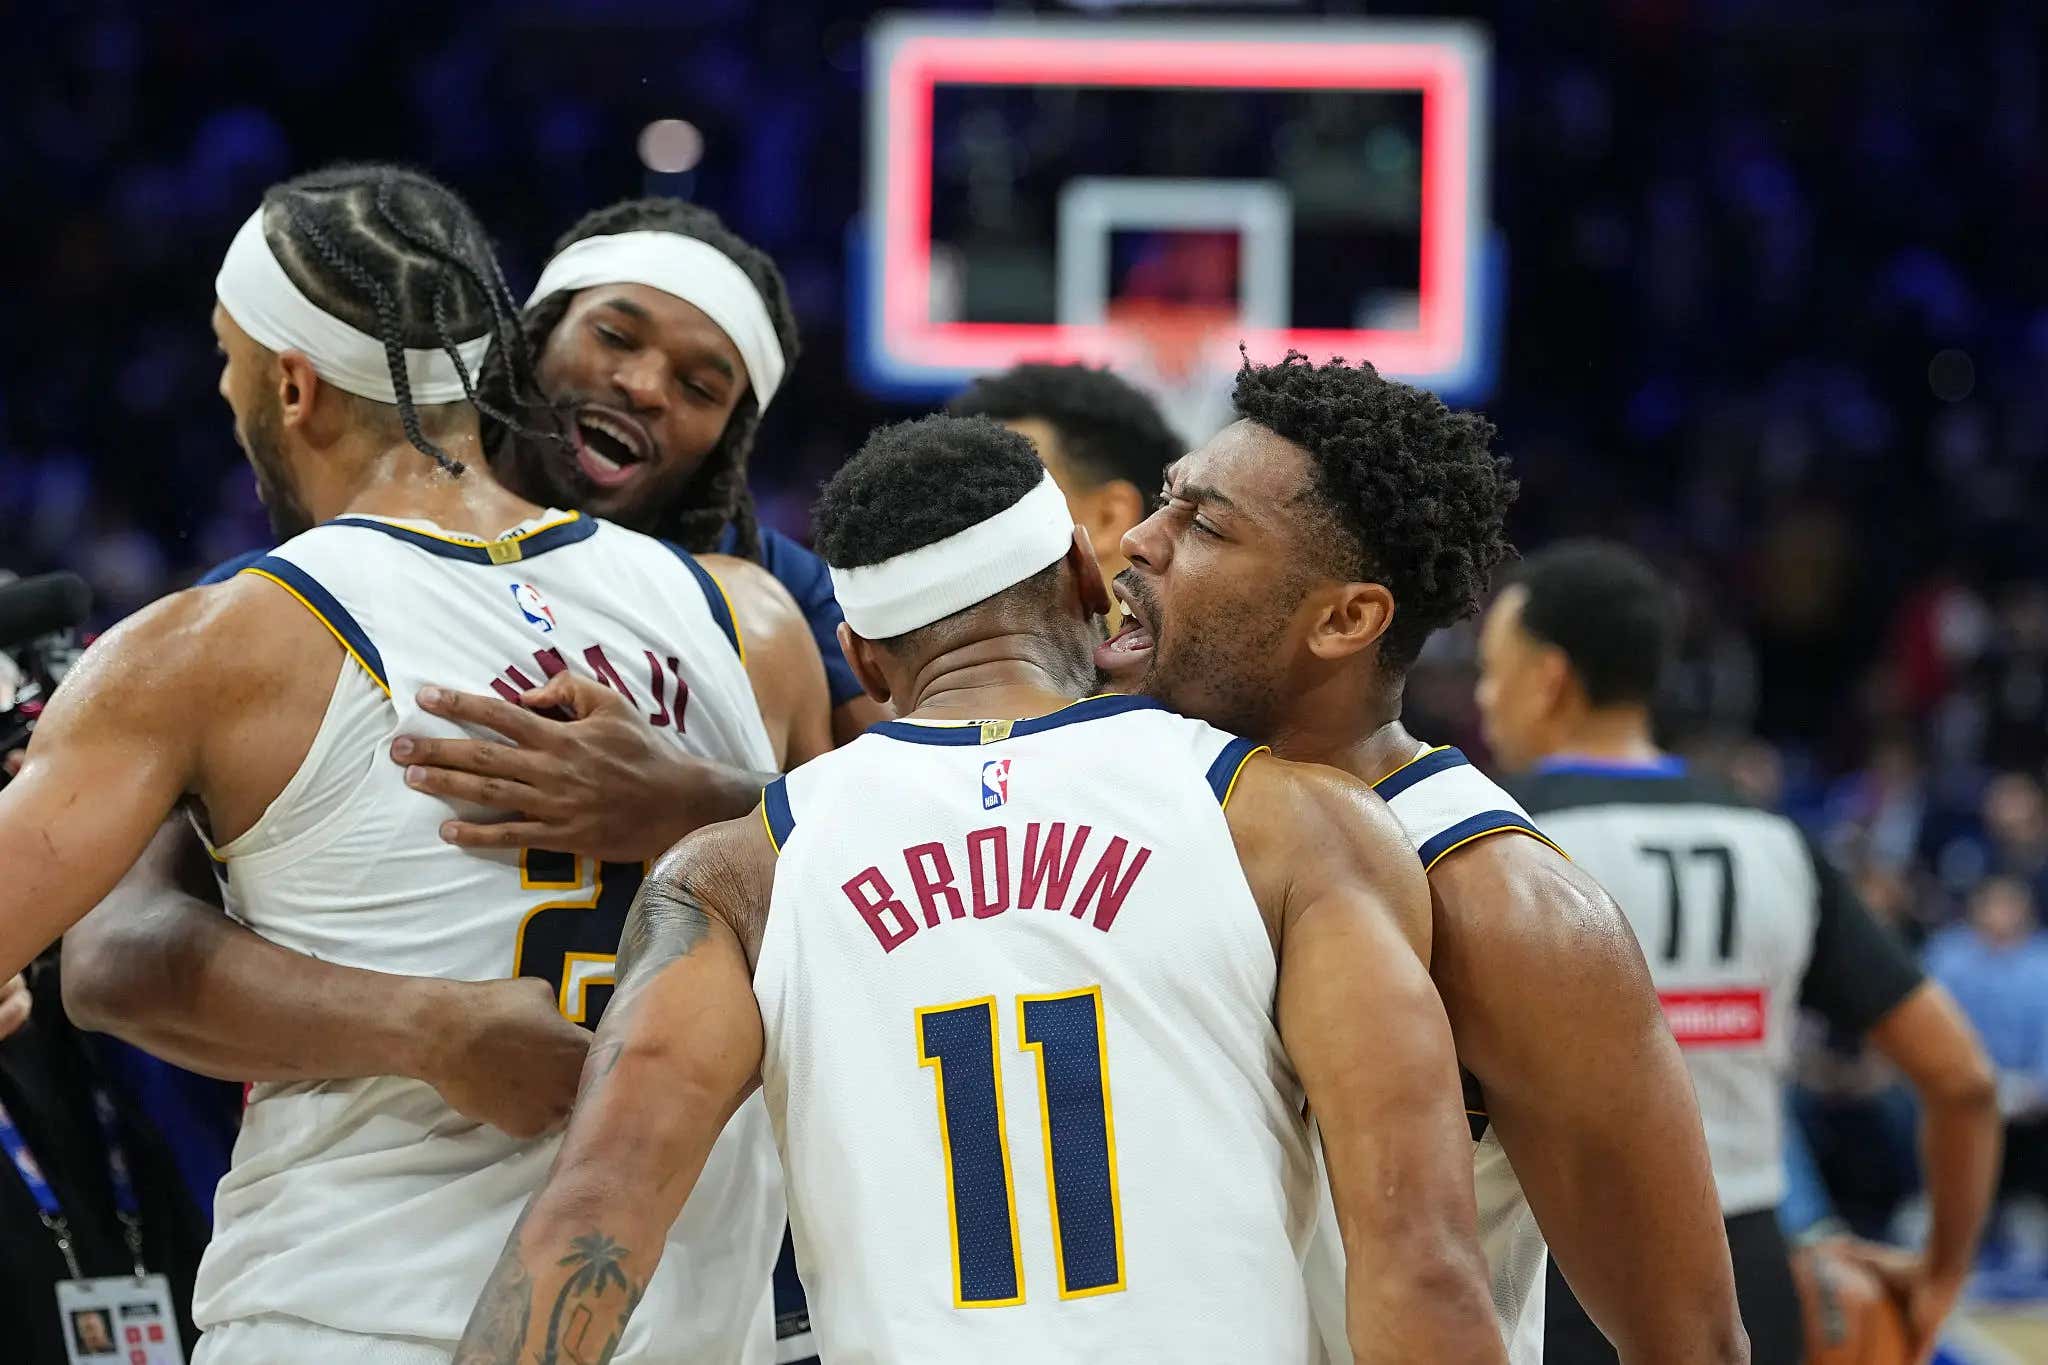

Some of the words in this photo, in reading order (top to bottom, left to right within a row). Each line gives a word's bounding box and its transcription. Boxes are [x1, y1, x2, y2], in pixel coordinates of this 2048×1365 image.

[984, 794, 999, 808] NBA
[841, 822, 1152, 954] BROWN
[1639, 844, 1738, 962] 77
[914, 984, 1127, 1309] 11
